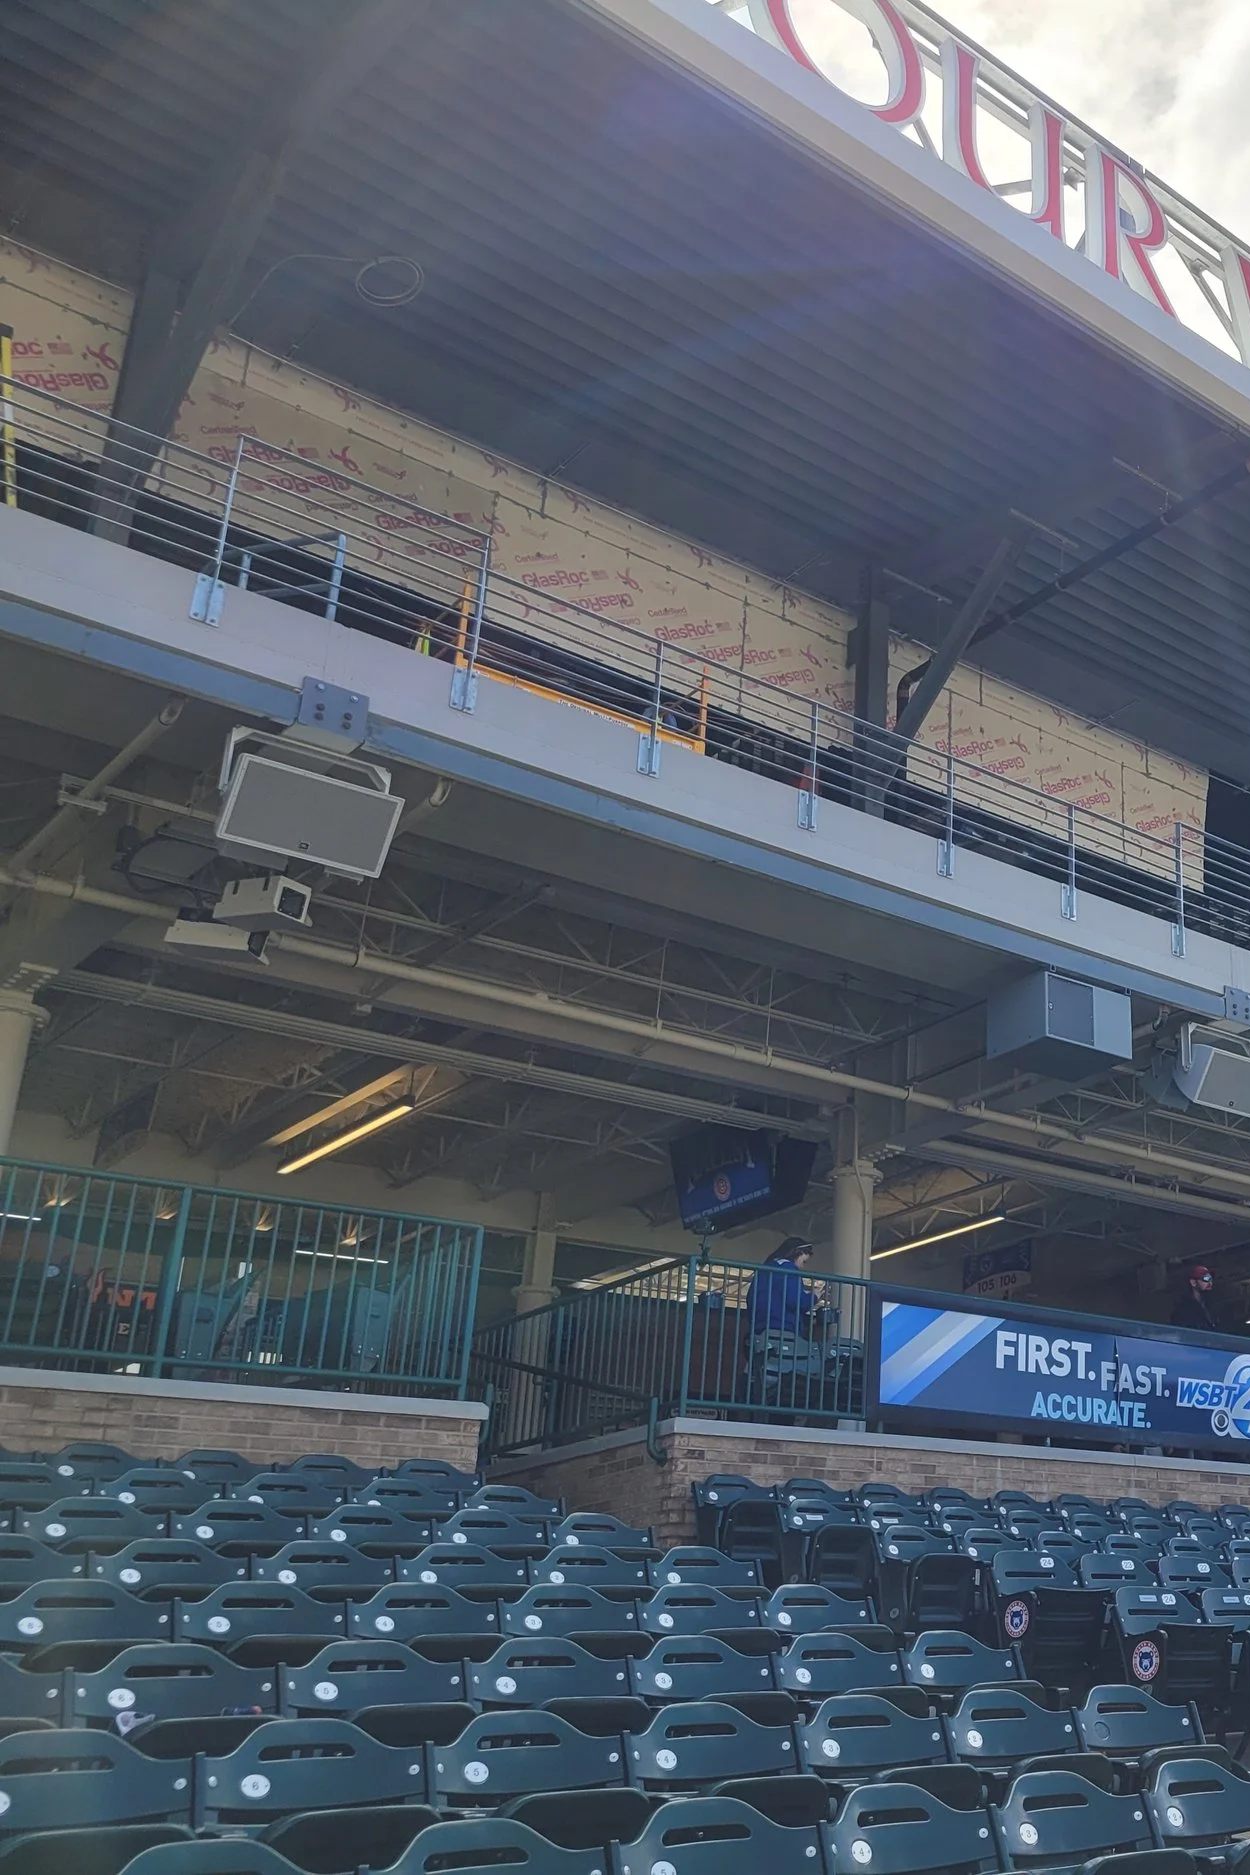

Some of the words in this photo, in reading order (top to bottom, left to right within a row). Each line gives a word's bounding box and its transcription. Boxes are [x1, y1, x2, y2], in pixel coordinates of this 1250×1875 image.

[521, 570, 590, 589] GlasRoc
[654, 621, 715, 642] GlasRoc
[1041, 777, 1082, 795] GlasRoc
[1135, 813, 1173, 832] GlasRoc
[995, 1330, 1096, 1381] FIRST.
[1100, 1360, 1170, 1398] FAST.
[1177, 1378, 1238, 1410] WSBT
[1030, 1391, 1152, 1429] ACCURATE.
